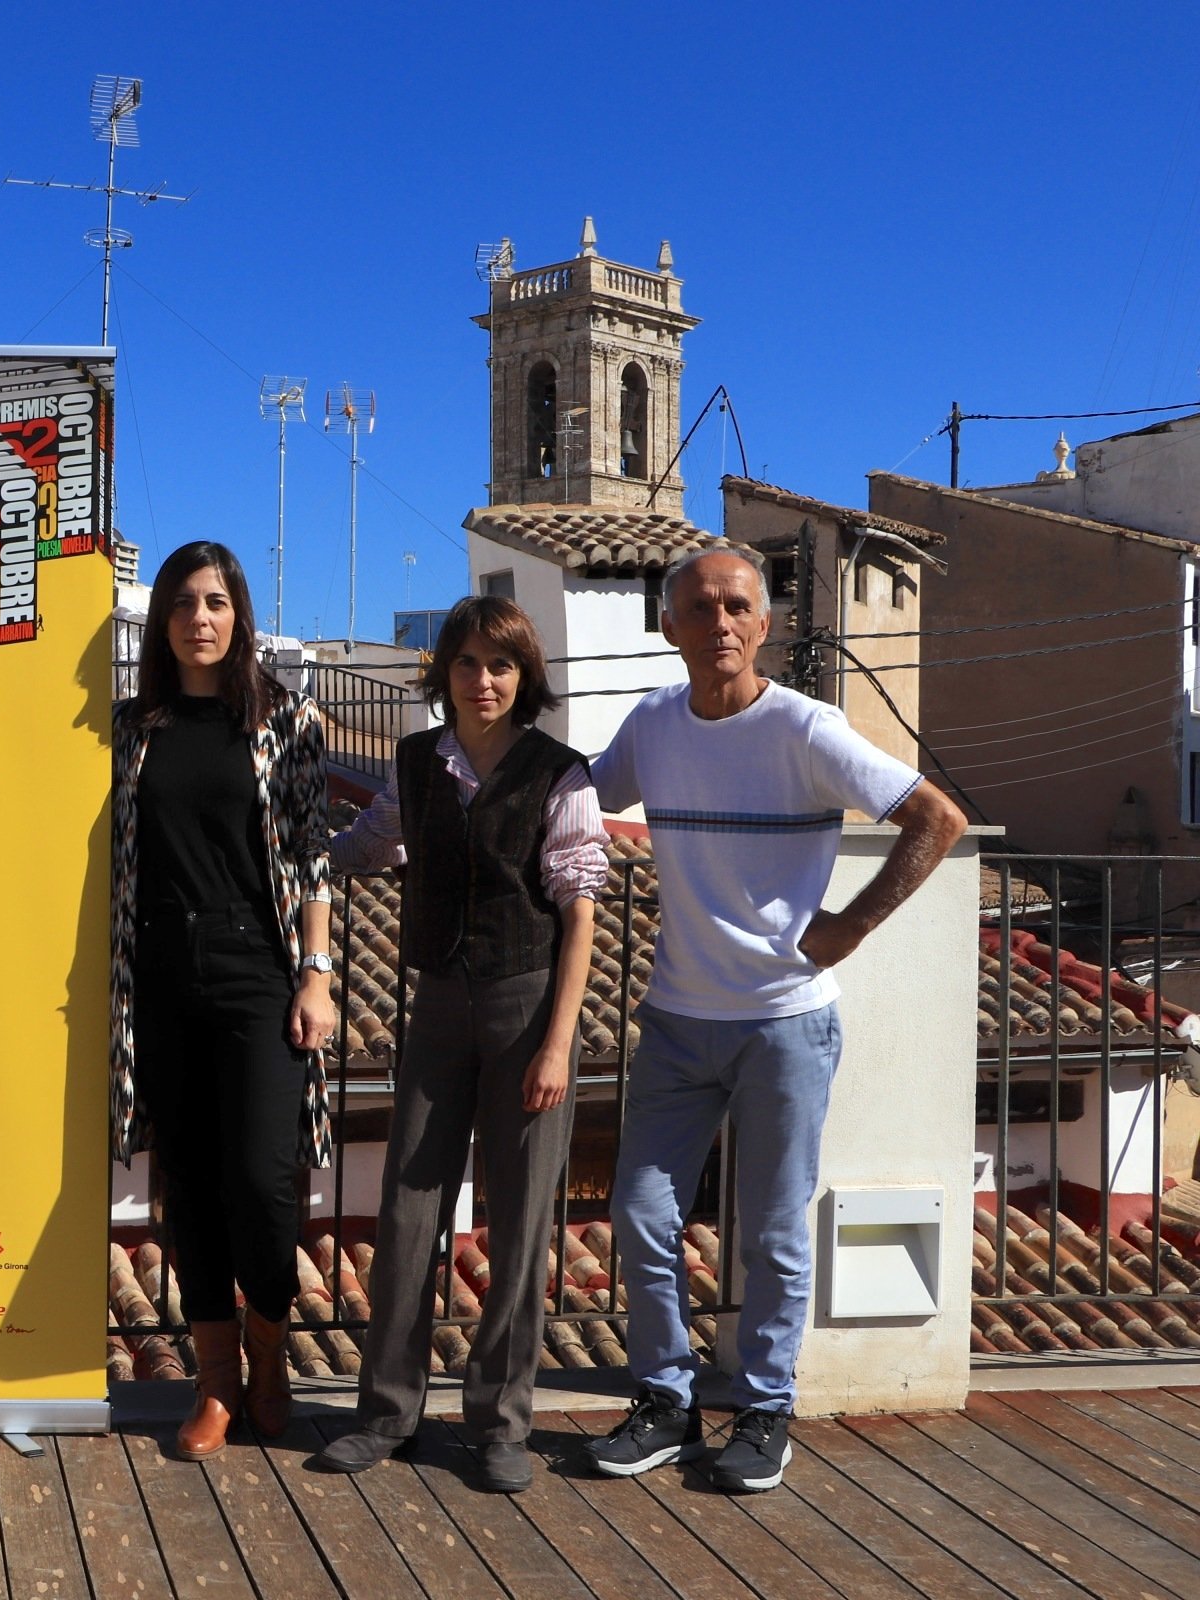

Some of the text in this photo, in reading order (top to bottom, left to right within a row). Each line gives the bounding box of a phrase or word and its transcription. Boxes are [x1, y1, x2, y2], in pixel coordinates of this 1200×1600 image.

[57, 392, 93, 538] OCTUBRE
[0, 478, 36, 625] OCTUBRE
[4, 1262, 28, 1270] Girona
